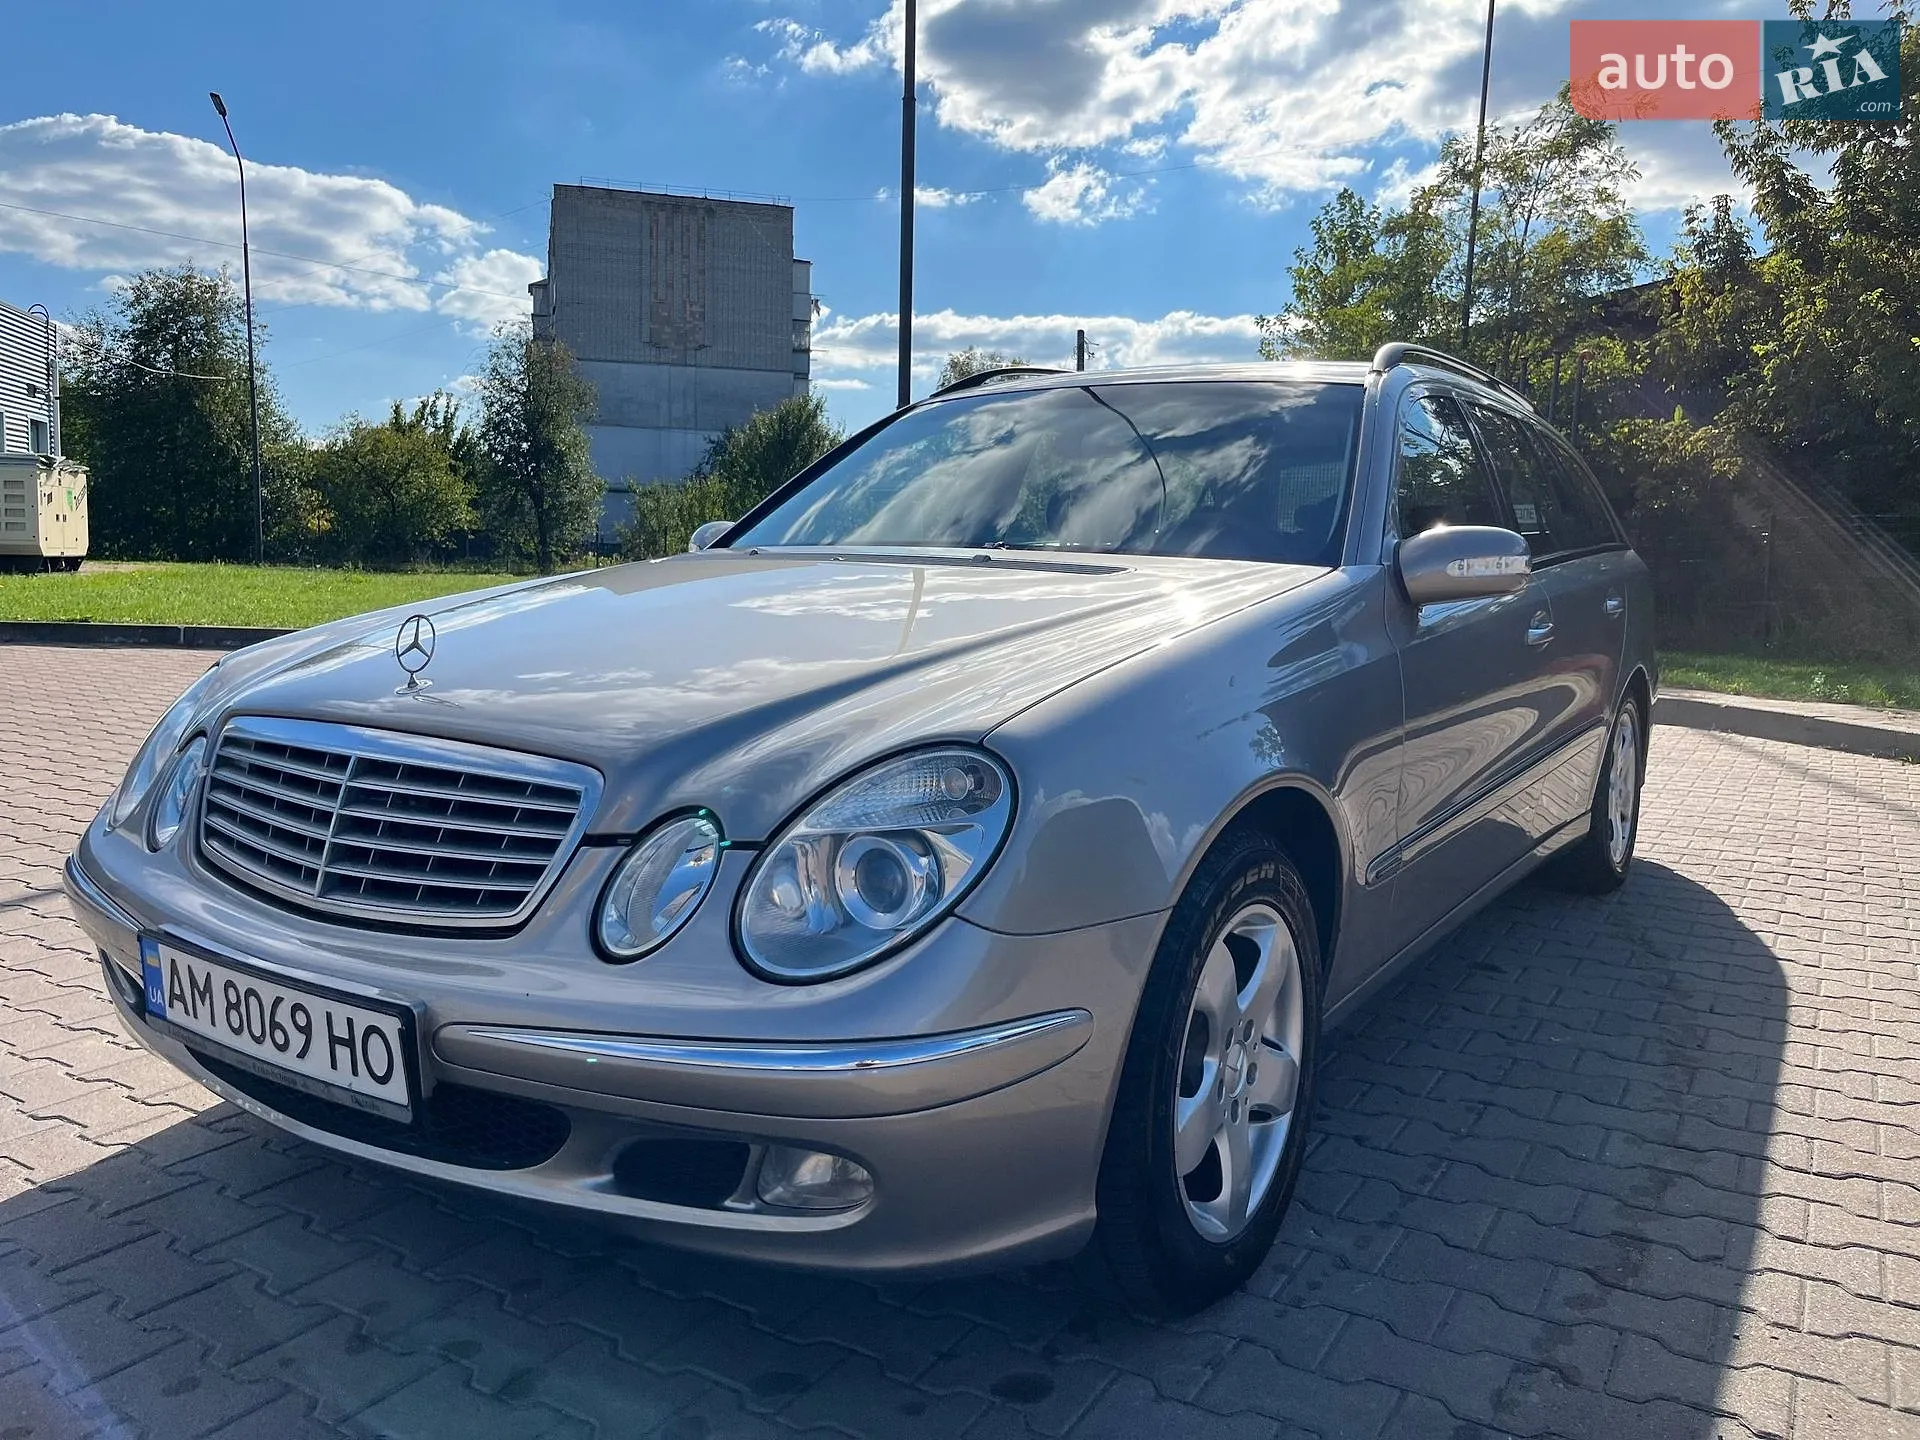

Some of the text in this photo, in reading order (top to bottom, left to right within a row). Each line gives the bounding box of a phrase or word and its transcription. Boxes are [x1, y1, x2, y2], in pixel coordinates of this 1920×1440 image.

[149, 985, 166, 1006] UA
[168, 958, 395, 1085] AM 8069 HO
